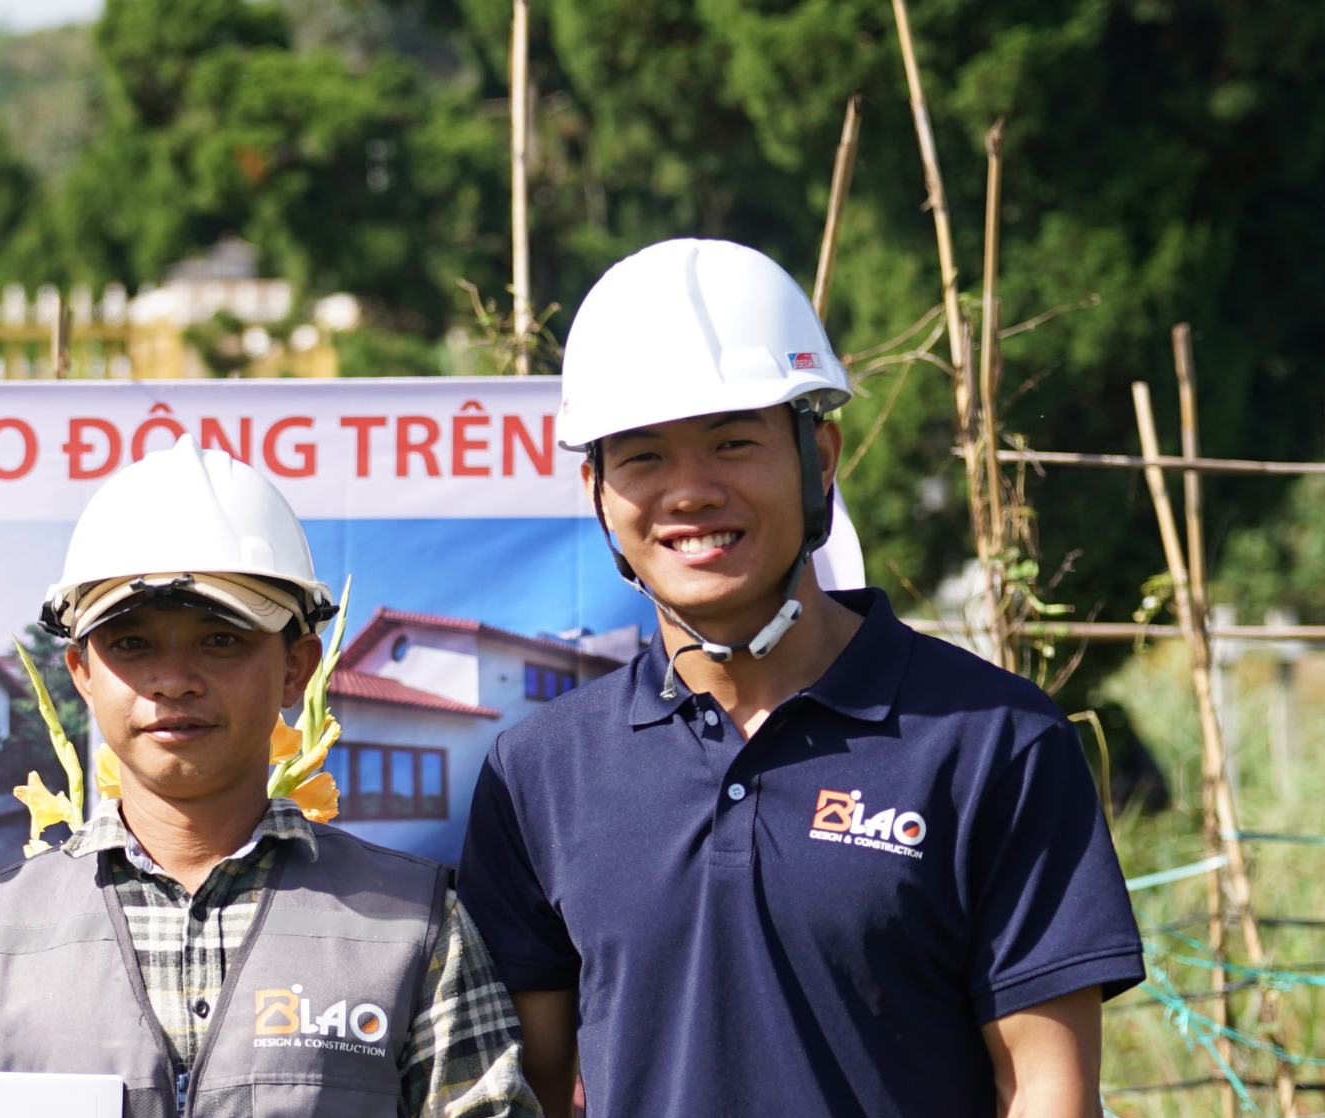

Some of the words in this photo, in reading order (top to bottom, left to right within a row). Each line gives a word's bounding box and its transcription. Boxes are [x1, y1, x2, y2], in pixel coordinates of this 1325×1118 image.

[340, 399, 556, 479] TRÊN
[809, 829, 843, 843] DESIGN
[843, 835, 852, 844] &
[854, 836, 924, 860] CONSTRUCTION
[253, 1037, 292, 1048] DESIGN
[294, 1038, 302, 1047] &
[305, 1038, 386, 1058] CONSTRUCTION
